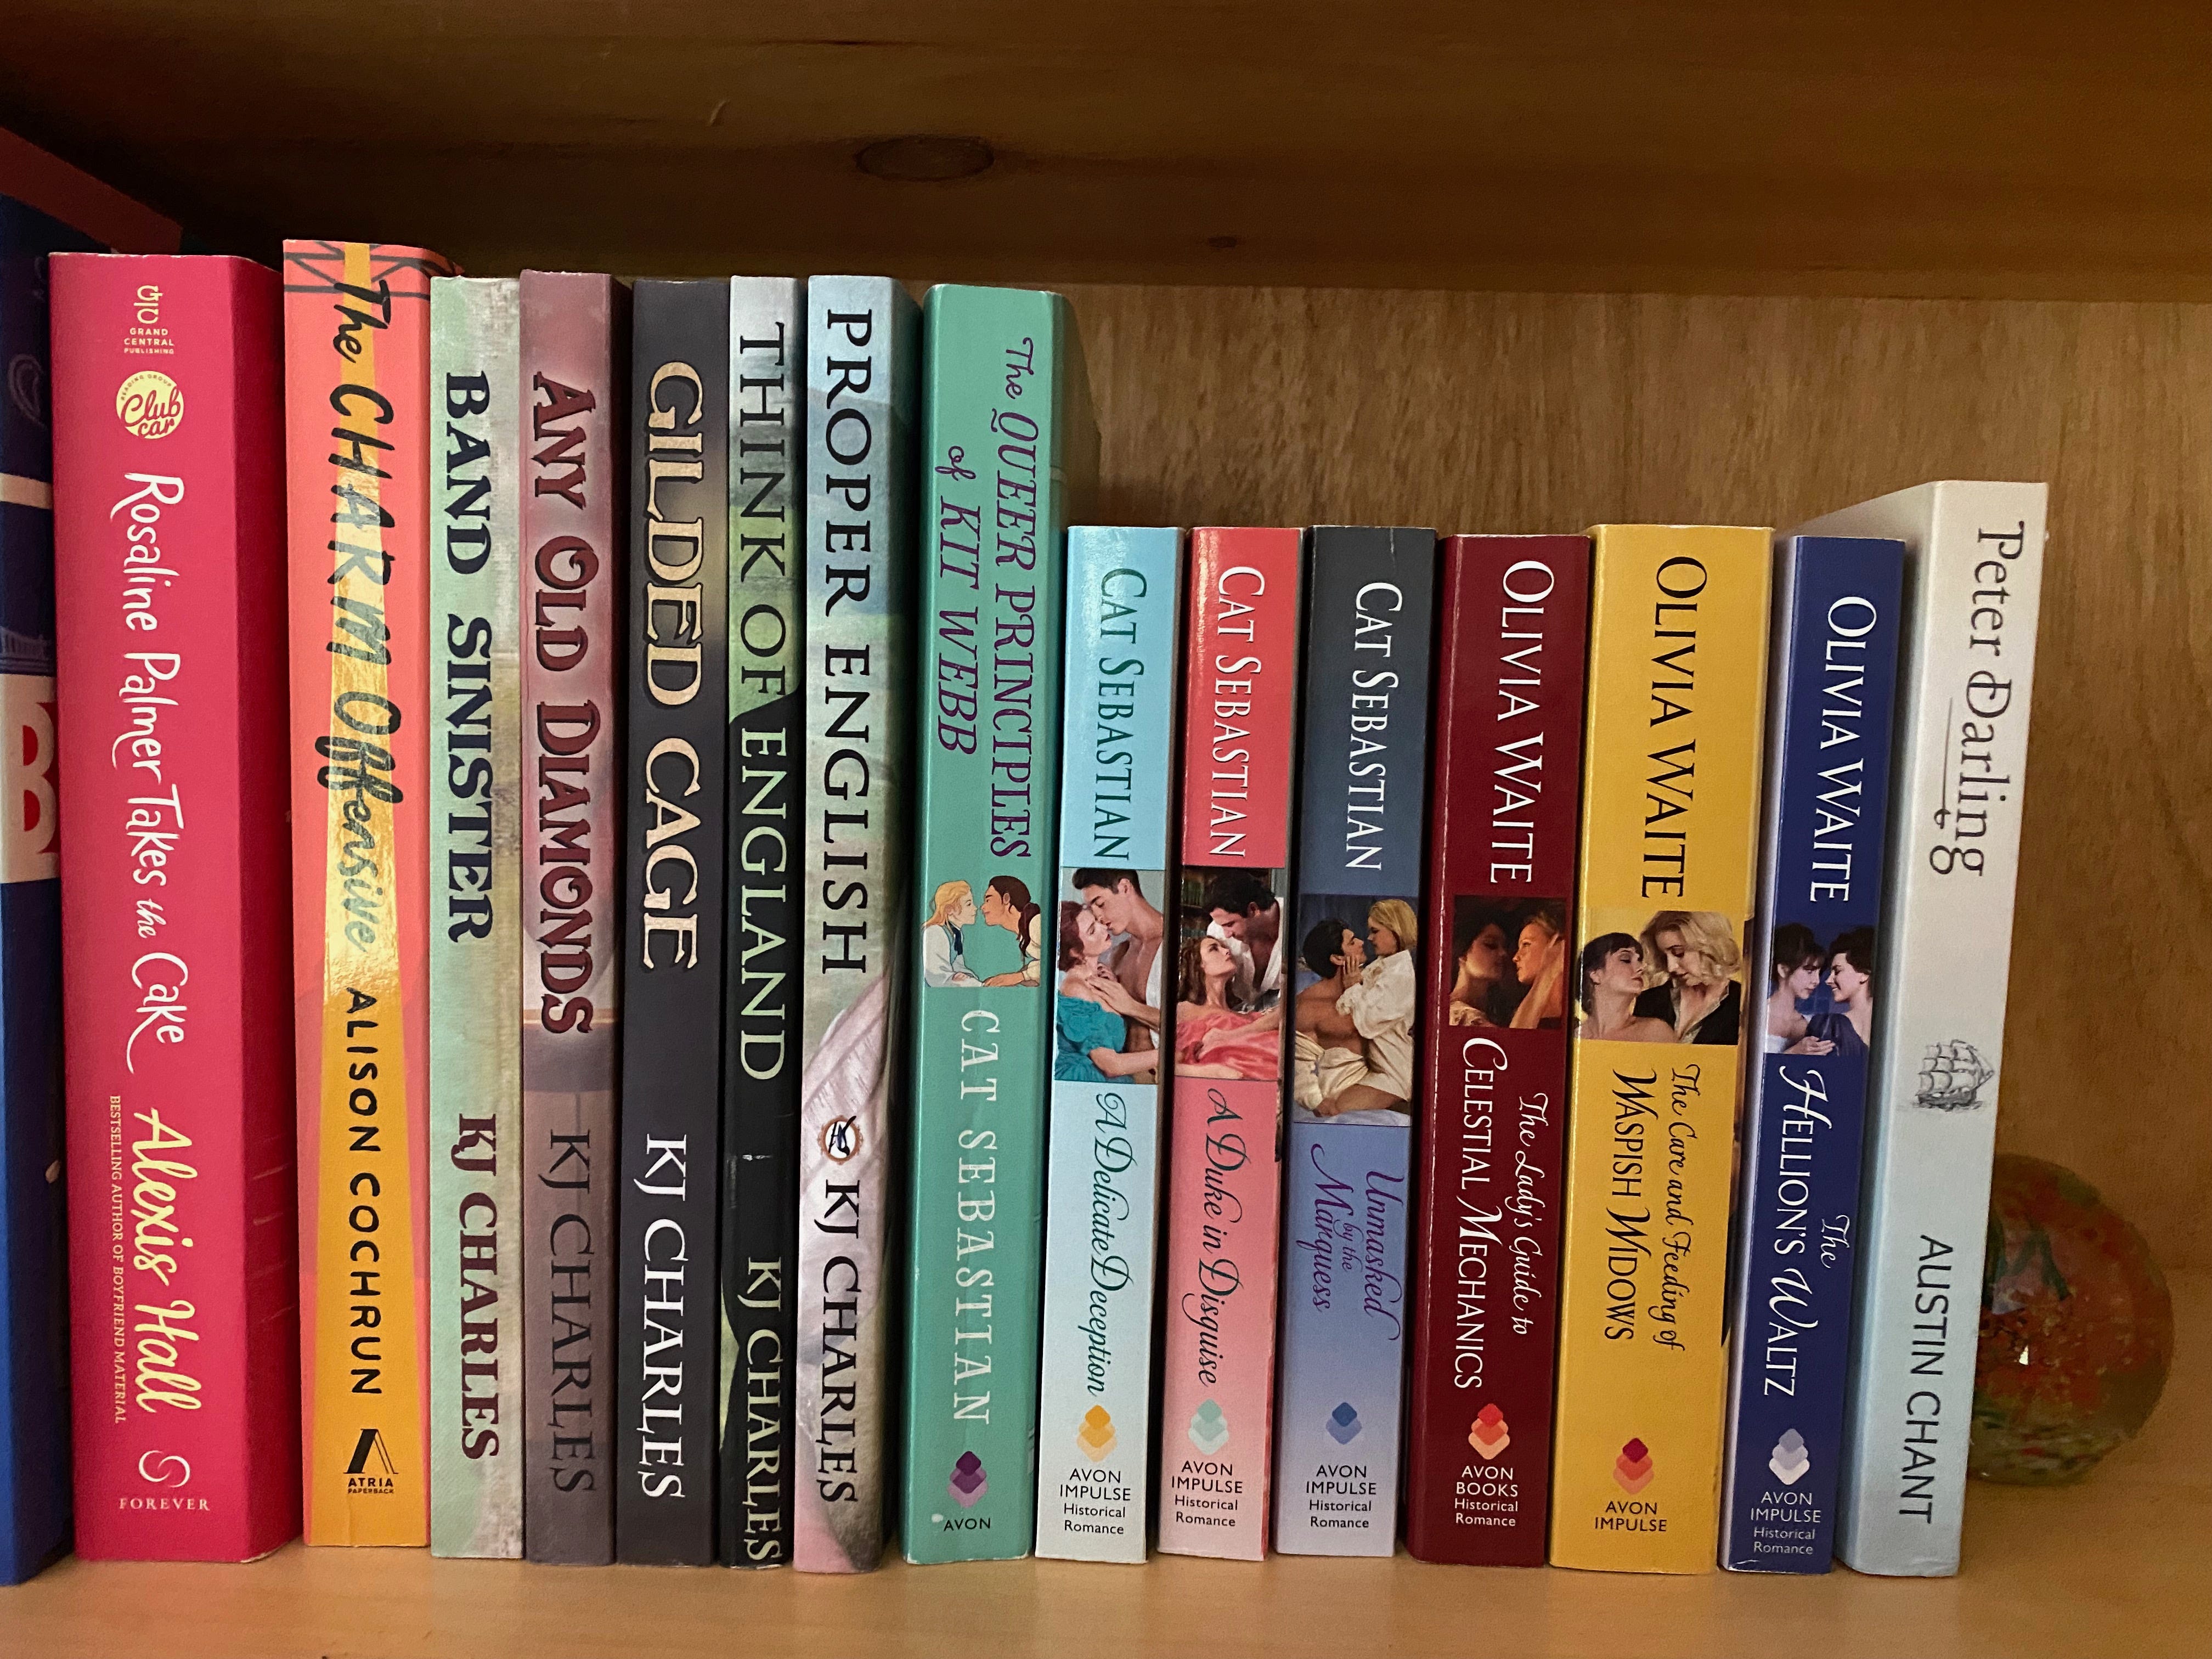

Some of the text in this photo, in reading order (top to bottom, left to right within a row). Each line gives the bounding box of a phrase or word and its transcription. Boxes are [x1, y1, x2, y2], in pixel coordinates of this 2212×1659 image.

[123, 338, 174, 346] CENTRAL
[129, 328, 168, 336] GRAND
[332, 279, 392, 364] The
[121, 374, 172, 400] READING GROUP
[121, 386, 182, 427] Club
[138, 418, 175, 437] car
[935, 445, 980, 755] of KIT WEBB
[990, 337, 1039, 857] The QUEER PRINCIPLES
[444, 370, 493, 943] BAND SINISTER
[822, 308, 873, 974] PROPER ENGLISH
[643, 362, 703, 970] GILDED CAGE
[531, 371, 601, 1034] ANY OLD DIAMONDS
[740, 321, 787, 1080] THINK OF ENGLAND
[1928, 520, 2025, 877] Peter Darling
[110, 472, 188, 1074] Rosaline Palmer Takes the Cake
[314, 691, 404, 953] Offensive
[346, 987, 382, 1394] ALISON COCHRUN
[1647, 1063, 1701, 1352] The Care and Feeding of
[953, 1009, 1000, 1425] CAT SEBASTIAN
[1296, 1143, 1353, 1312] Marquess
[1504, 1092, 1549, 1335] The Lady's Guide to
[1078, 1092, 1138, 1396] A Delicate Deception
[1182, 1087, 1251, 1387] A Duke in Disguise
[1333, 1219, 1363, 1272] by the
[1363, 1171, 1404, 1341] Unmasked
[1821, 1214, 1850, 1269] The
[110, 1095, 127, 1424] BESTSELLING AUTHOR OF BOYFRIEND MATERIAL
[130, 1107, 201, 1413] Alexis Hall
[451, 1113, 499, 1459] KJ CHARLES
[538, 1128, 596, 1493] KJ CHARLES
[633, 1133, 689, 1499] KJ CHARLES
[814, 1179, 861, 1503] KJ CHARLES
[1898, 1233, 1953, 1524] AUSTIN CHANT
[737, 1256, 783, 1560] KJ CHARLES
[348, 1477, 394, 1488] ATRIA
[1069, 1468, 1121, 1483] AVON
[1171, 1475, 1243, 1493] IMPULSE
[1182, 1460, 1233, 1476] AVON
[1306, 1481, 1376, 1495] IMPULSE
[1316, 1465, 1367, 1478] AVON
[1462, 1465, 1514, 1480] AVON
[119, 1498, 211, 1511] FOREVER
[1060, 1485, 1131, 1501] IMPULSE
[1175, 1496, 1238, 1510] Historical
[1309, 1499, 1372, 1512] Historical
[1454, 1498, 1518, 1512] Historical
[1457, 1482, 1519, 1497] BOOKS
[1605, 1501, 1657, 1515] AVON
[1761, 1491, 1813, 1505] AVON
[944, 1517, 991, 1532] AVON
[1064, 1503, 1125, 1518] Historical
[1064, 1520, 1124, 1534] Romance
[1176, 1512, 1235, 1527] Romance
[1311, 1516, 1369, 1528] Romance
[1455, 1513, 1516, 1527] Romance
[1595, 1516, 1667, 1532] IMPULSE
[1751, 1508, 1821, 1523] IMPULSE
[1753, 1542, 1813, 1555] Romance
[1754, 1526, 1815, 1540] Historical
